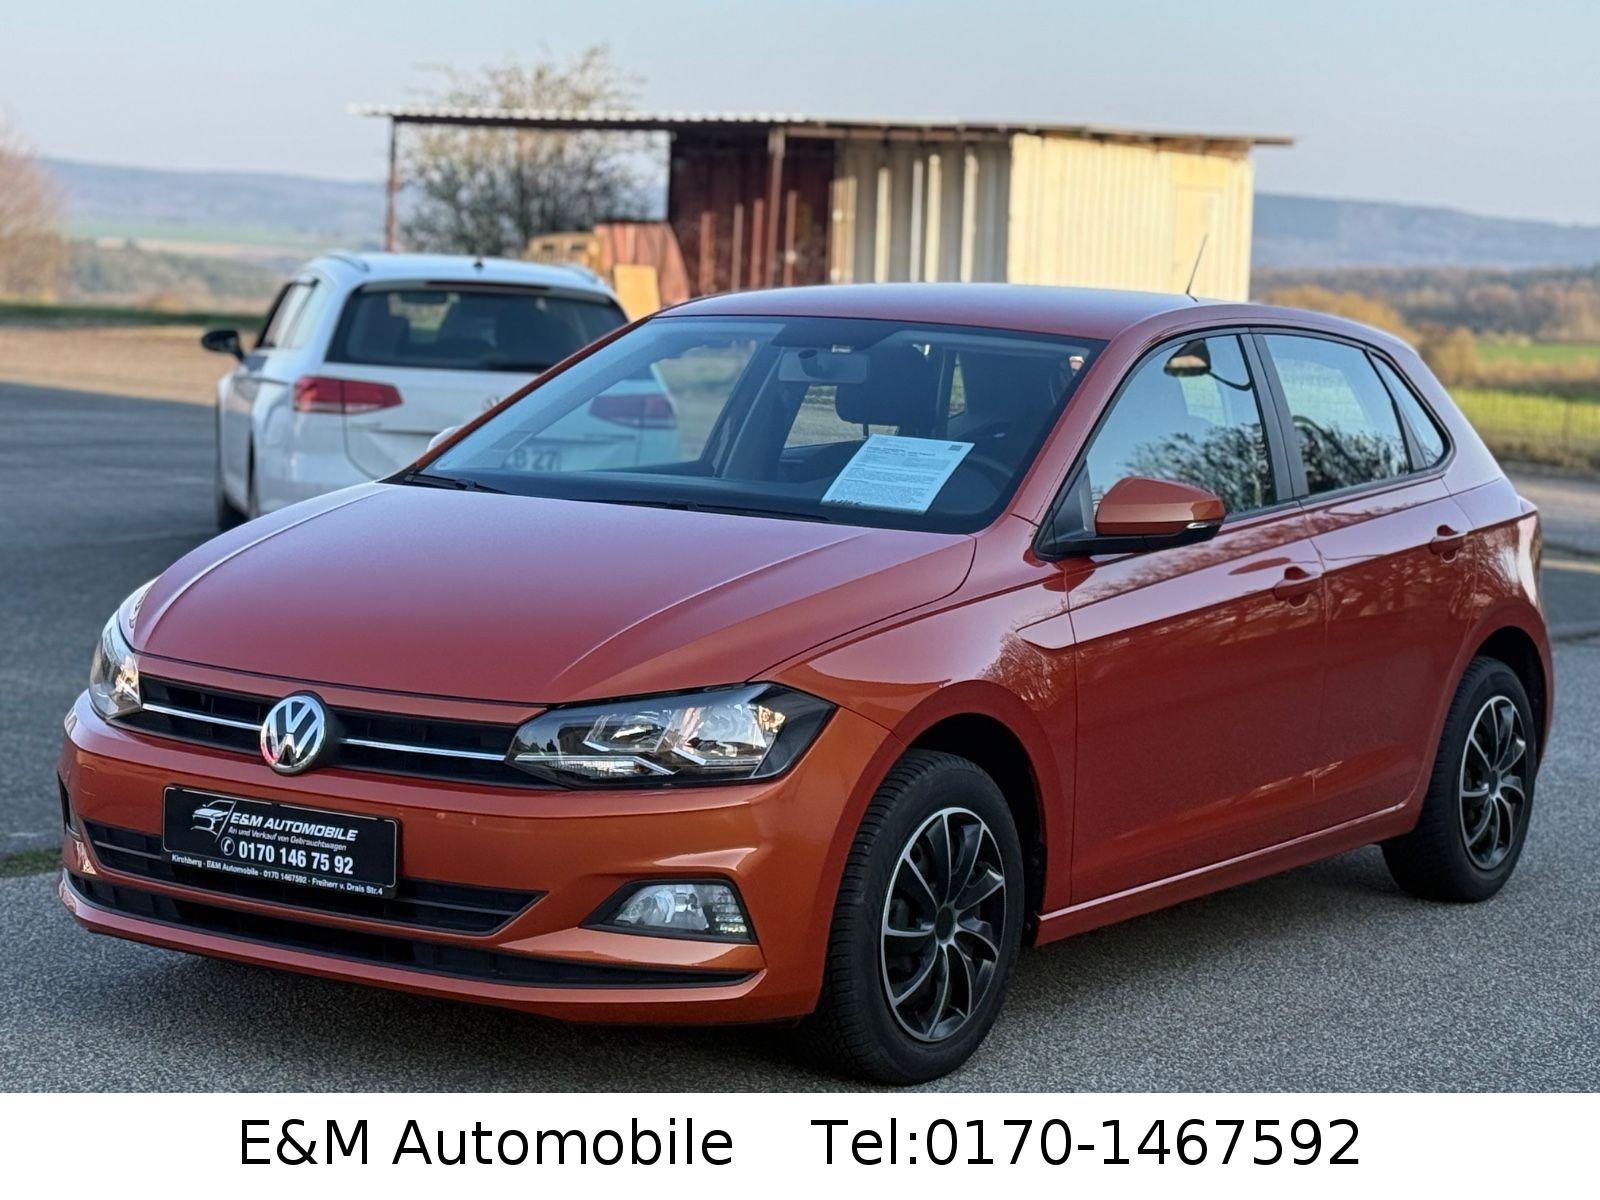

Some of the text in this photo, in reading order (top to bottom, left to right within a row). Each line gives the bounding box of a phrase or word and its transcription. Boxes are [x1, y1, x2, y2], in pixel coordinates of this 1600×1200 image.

[228, 826, 238, 834] An
[239, 828, 251, 837] und
[251, 830, 278, 840] Verkauf
[290, 836, 347, 852] Gebrauchtwagen
[230, 812, 358, 841] E&M AUTOMOBILE
[171, 854, 203, 868] Kirchberg
[206, 860, 222, 870] E&M
[222, 862, 259, 876] Automobile
[263, 870, 279, 880] 0170
[280, 873, 307, 884] 1467592
[312, 877, 338, 889] Freiherr
[346, 883, 365, 893] Drais
[239, 841, 354, 875] 0170 146 75 92
